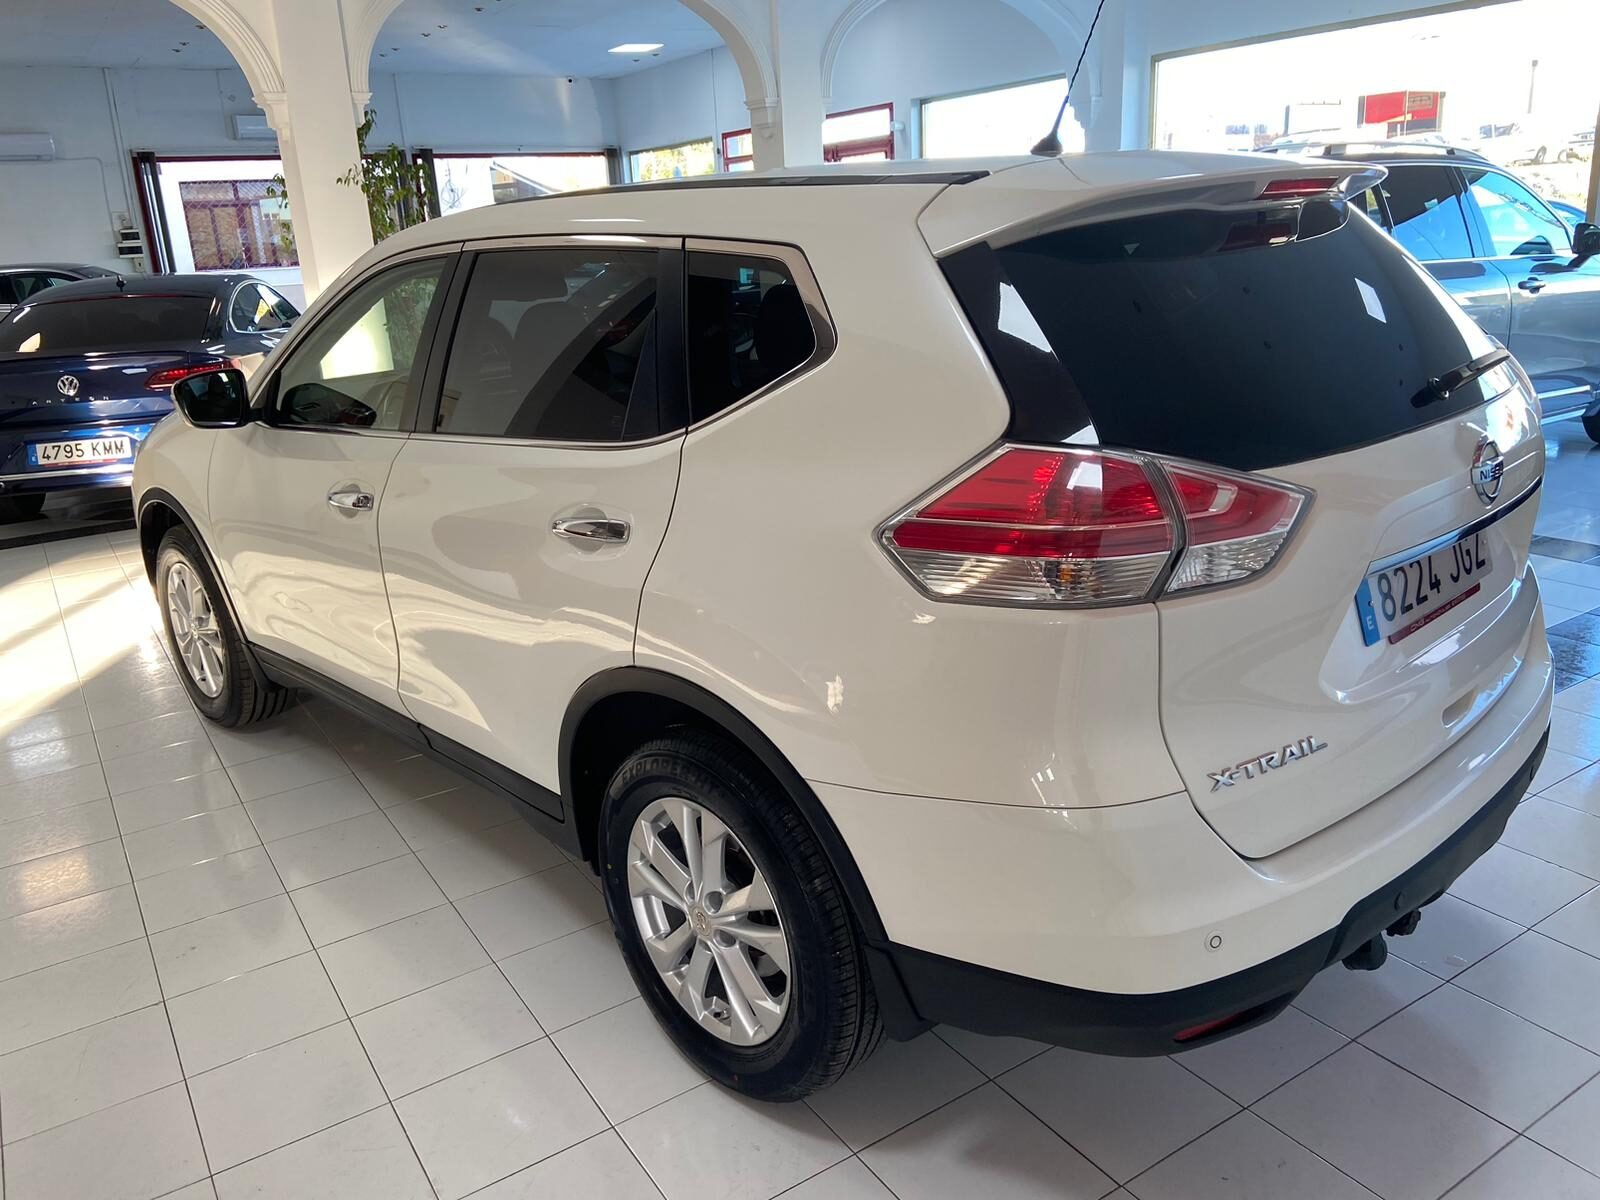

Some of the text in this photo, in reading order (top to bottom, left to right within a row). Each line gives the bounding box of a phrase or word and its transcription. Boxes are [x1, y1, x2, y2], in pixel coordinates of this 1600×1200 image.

[41, 440, 125, 461] 4795 KMM
[1377, 555, 1441, 621] 8224
[1366, 615, 1374, 630] E
[1206, 735, 1328, 793] X-TRAIL
